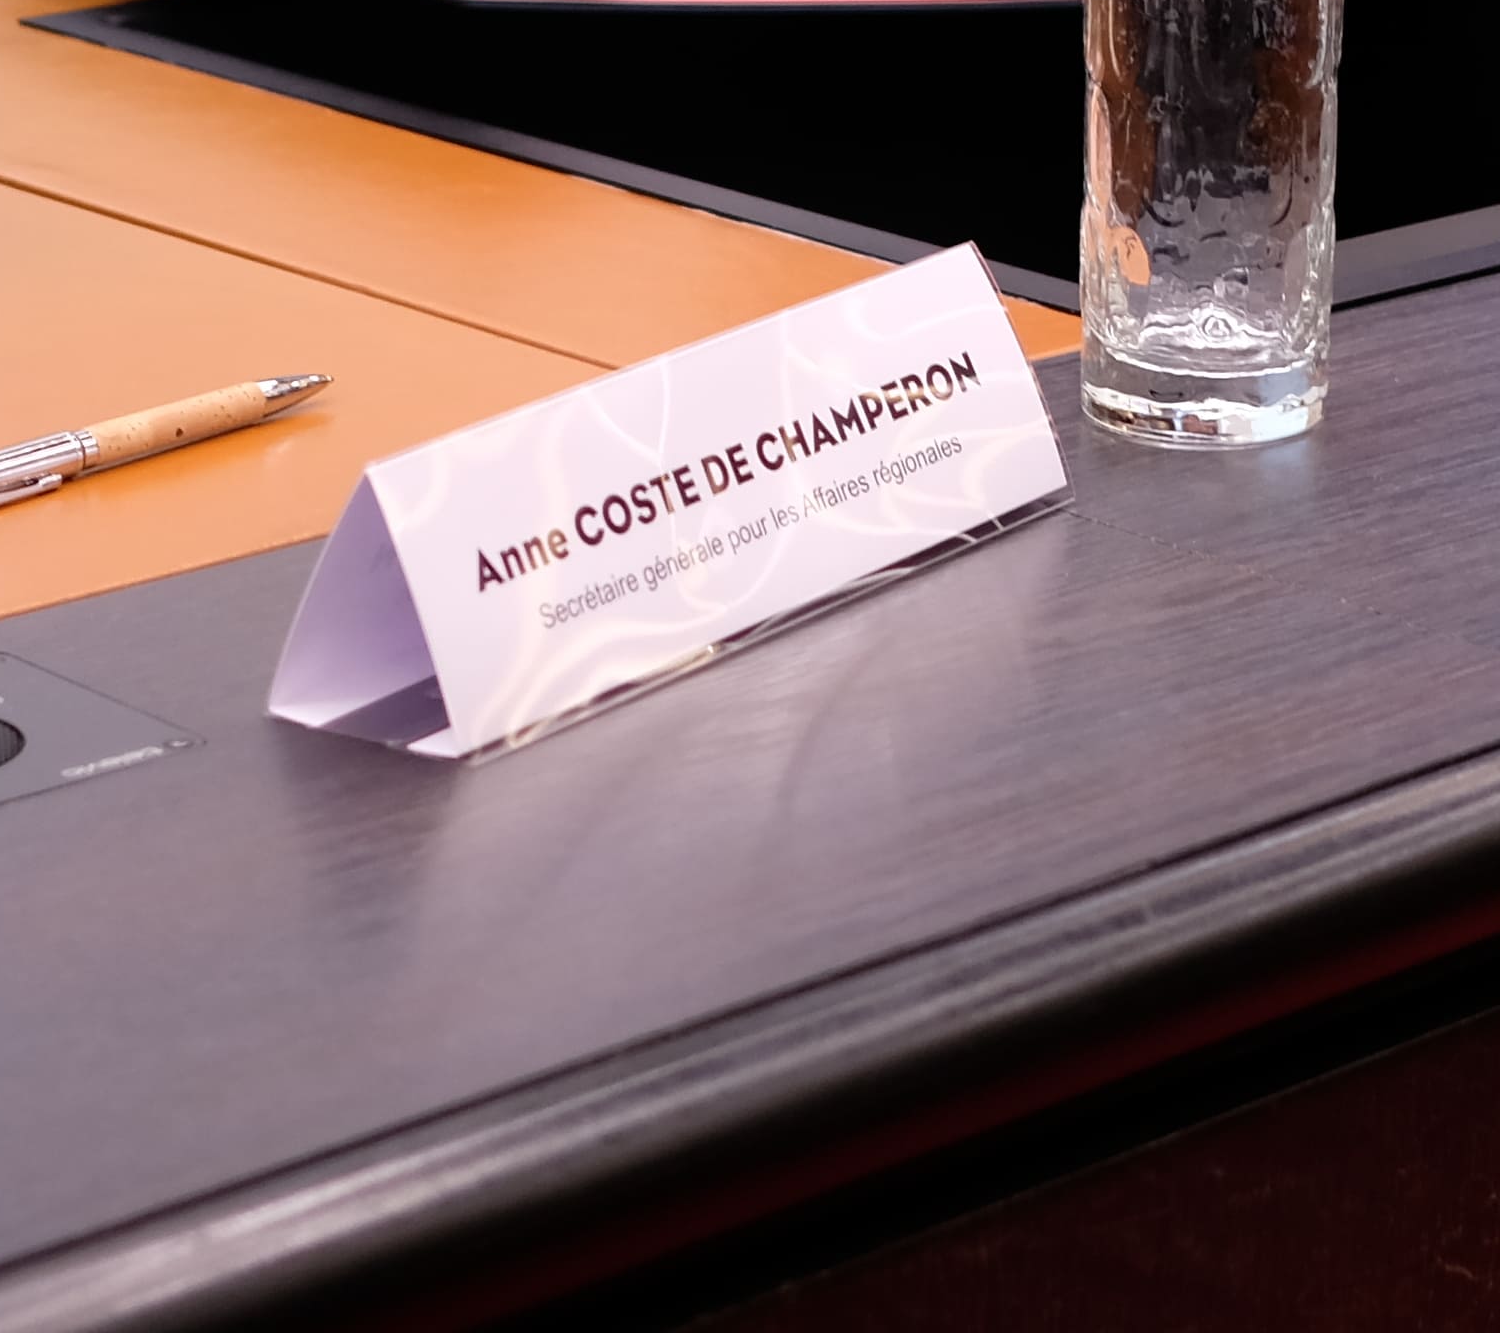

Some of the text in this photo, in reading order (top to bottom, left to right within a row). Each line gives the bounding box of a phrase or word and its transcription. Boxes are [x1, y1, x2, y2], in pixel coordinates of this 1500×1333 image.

[477, 350, 982, 593] Anne COSTE DE CHAMPERON
[539, 434, 963, 629] Secrétaire générale pour les Affaires régionales
